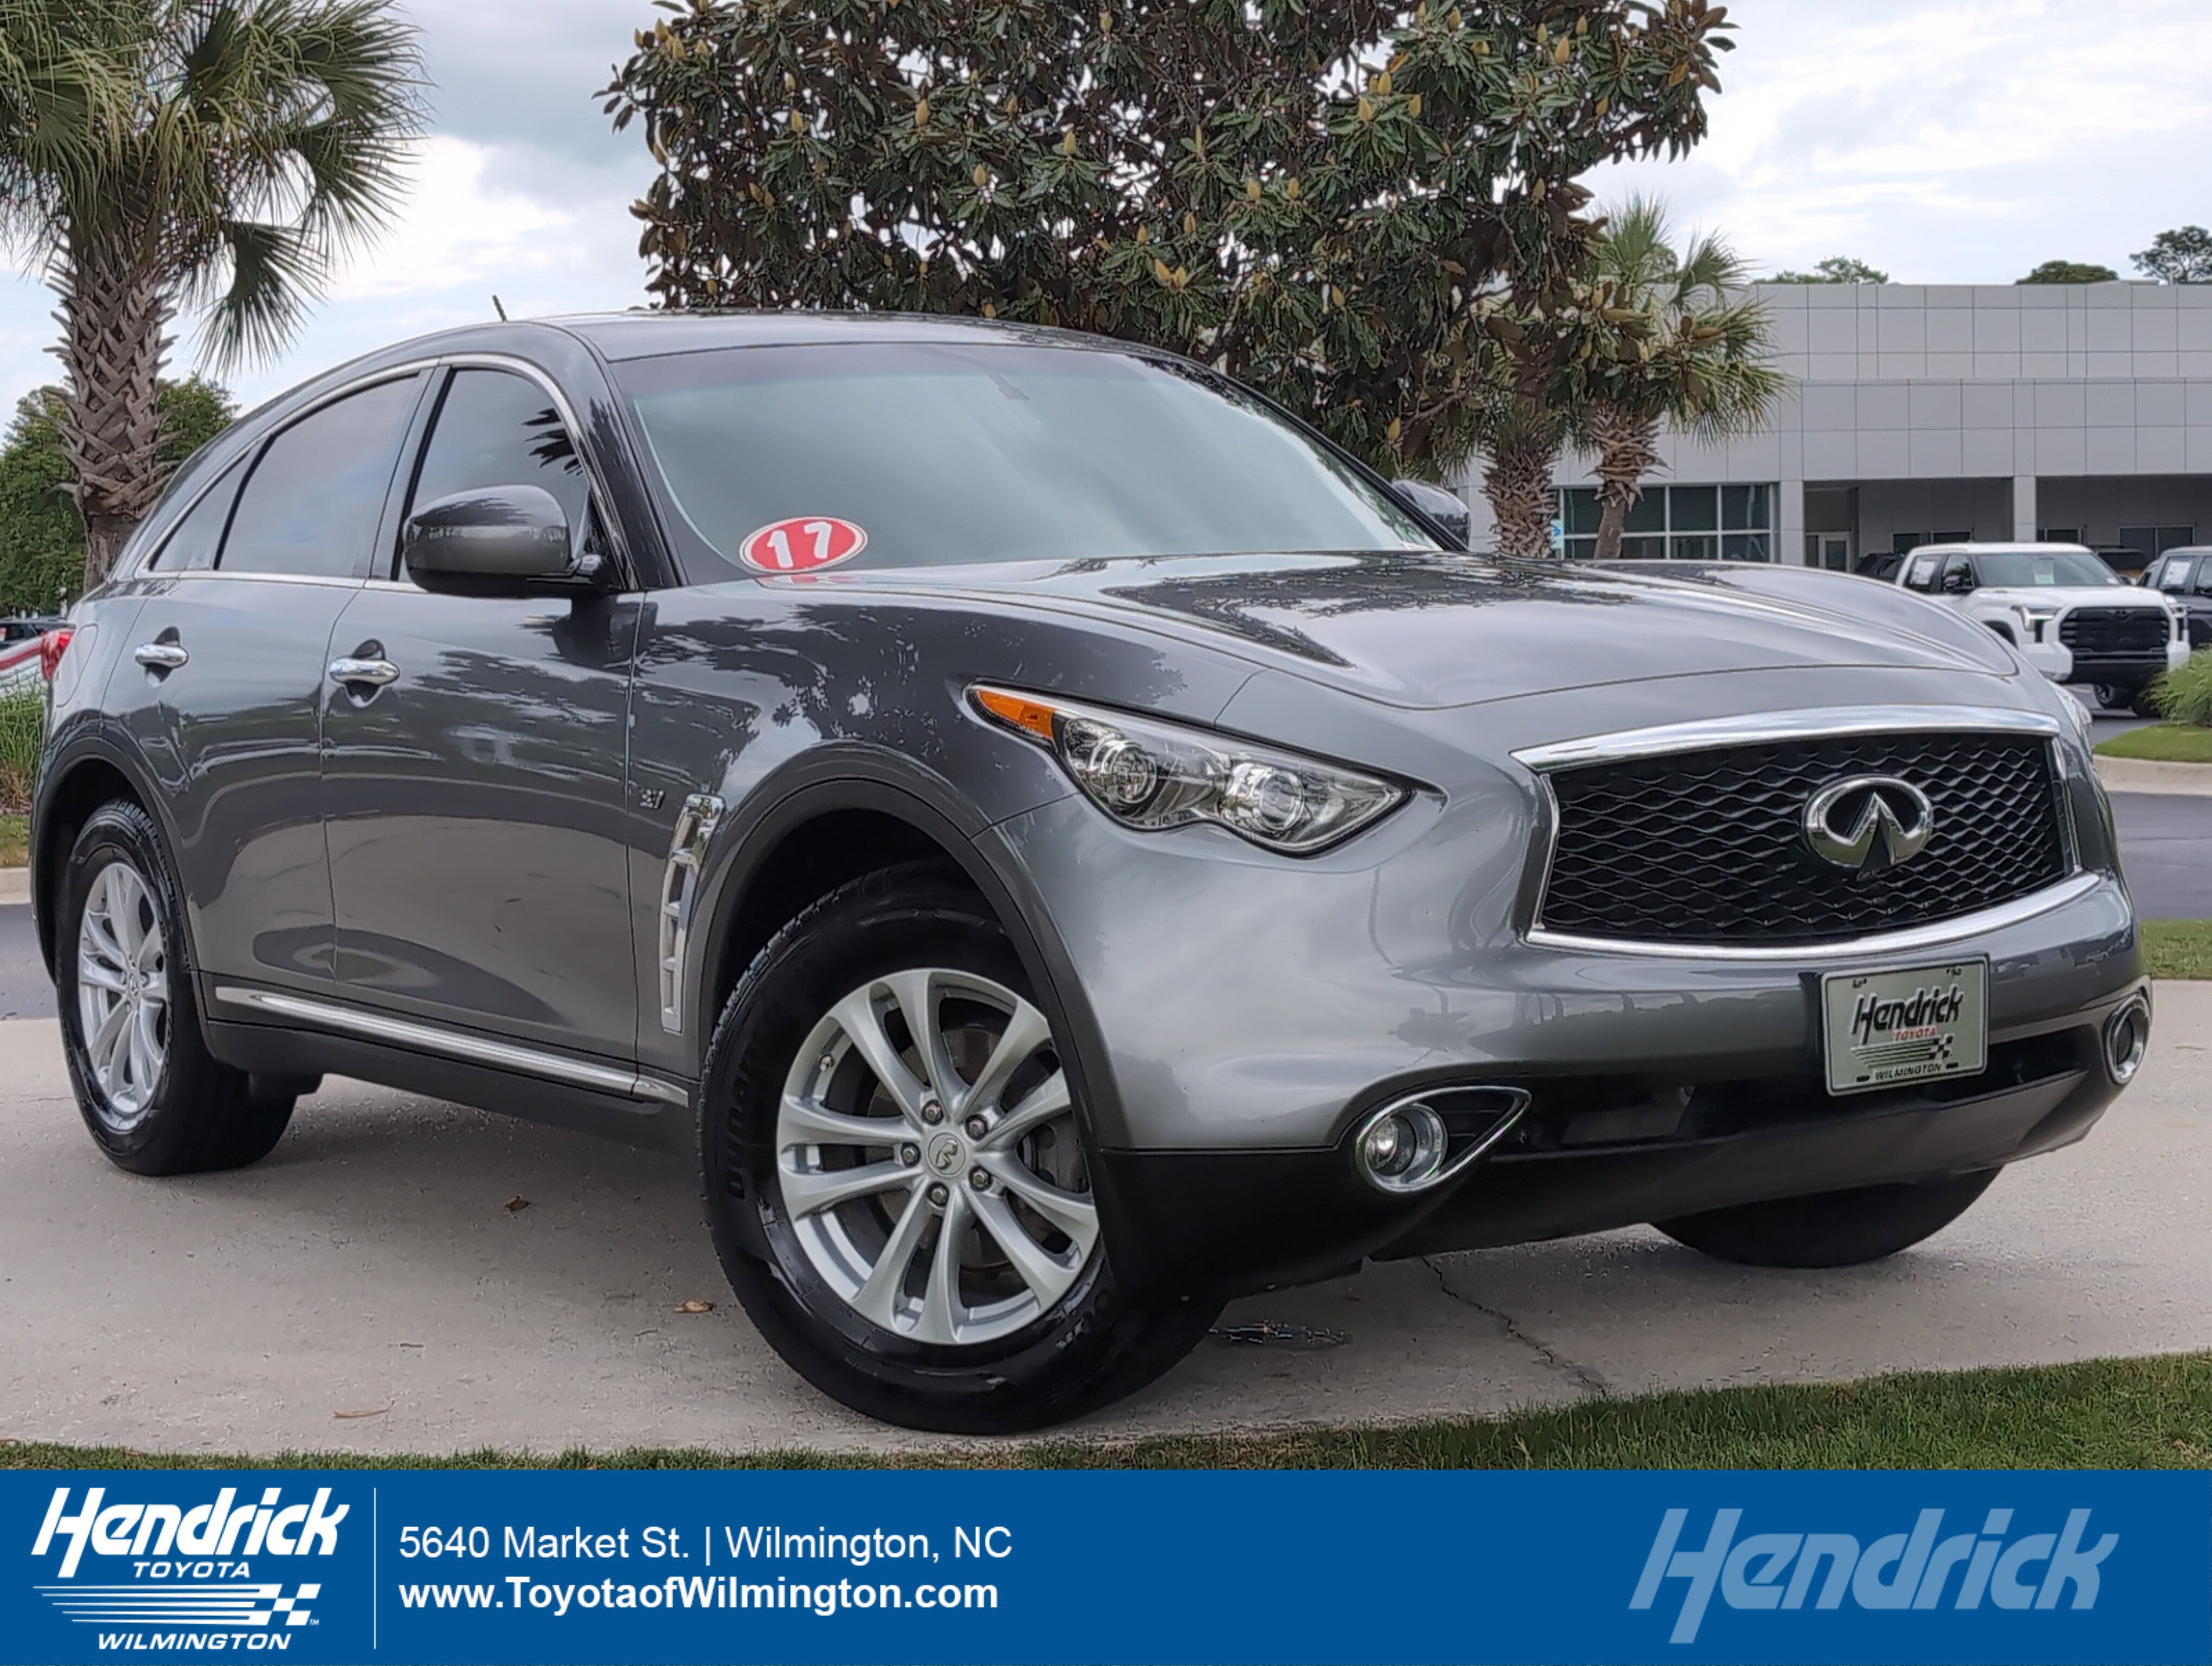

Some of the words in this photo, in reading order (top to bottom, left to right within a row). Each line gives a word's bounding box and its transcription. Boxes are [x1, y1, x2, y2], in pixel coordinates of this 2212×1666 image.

[767, 521, 833, 568] 17
[1851, 985, 1964, 1045] Hendrick
[1895, 1027, 1937, 1041] TOYOTA
[1875, 1063, 1942, 1081] WILMINGTON
